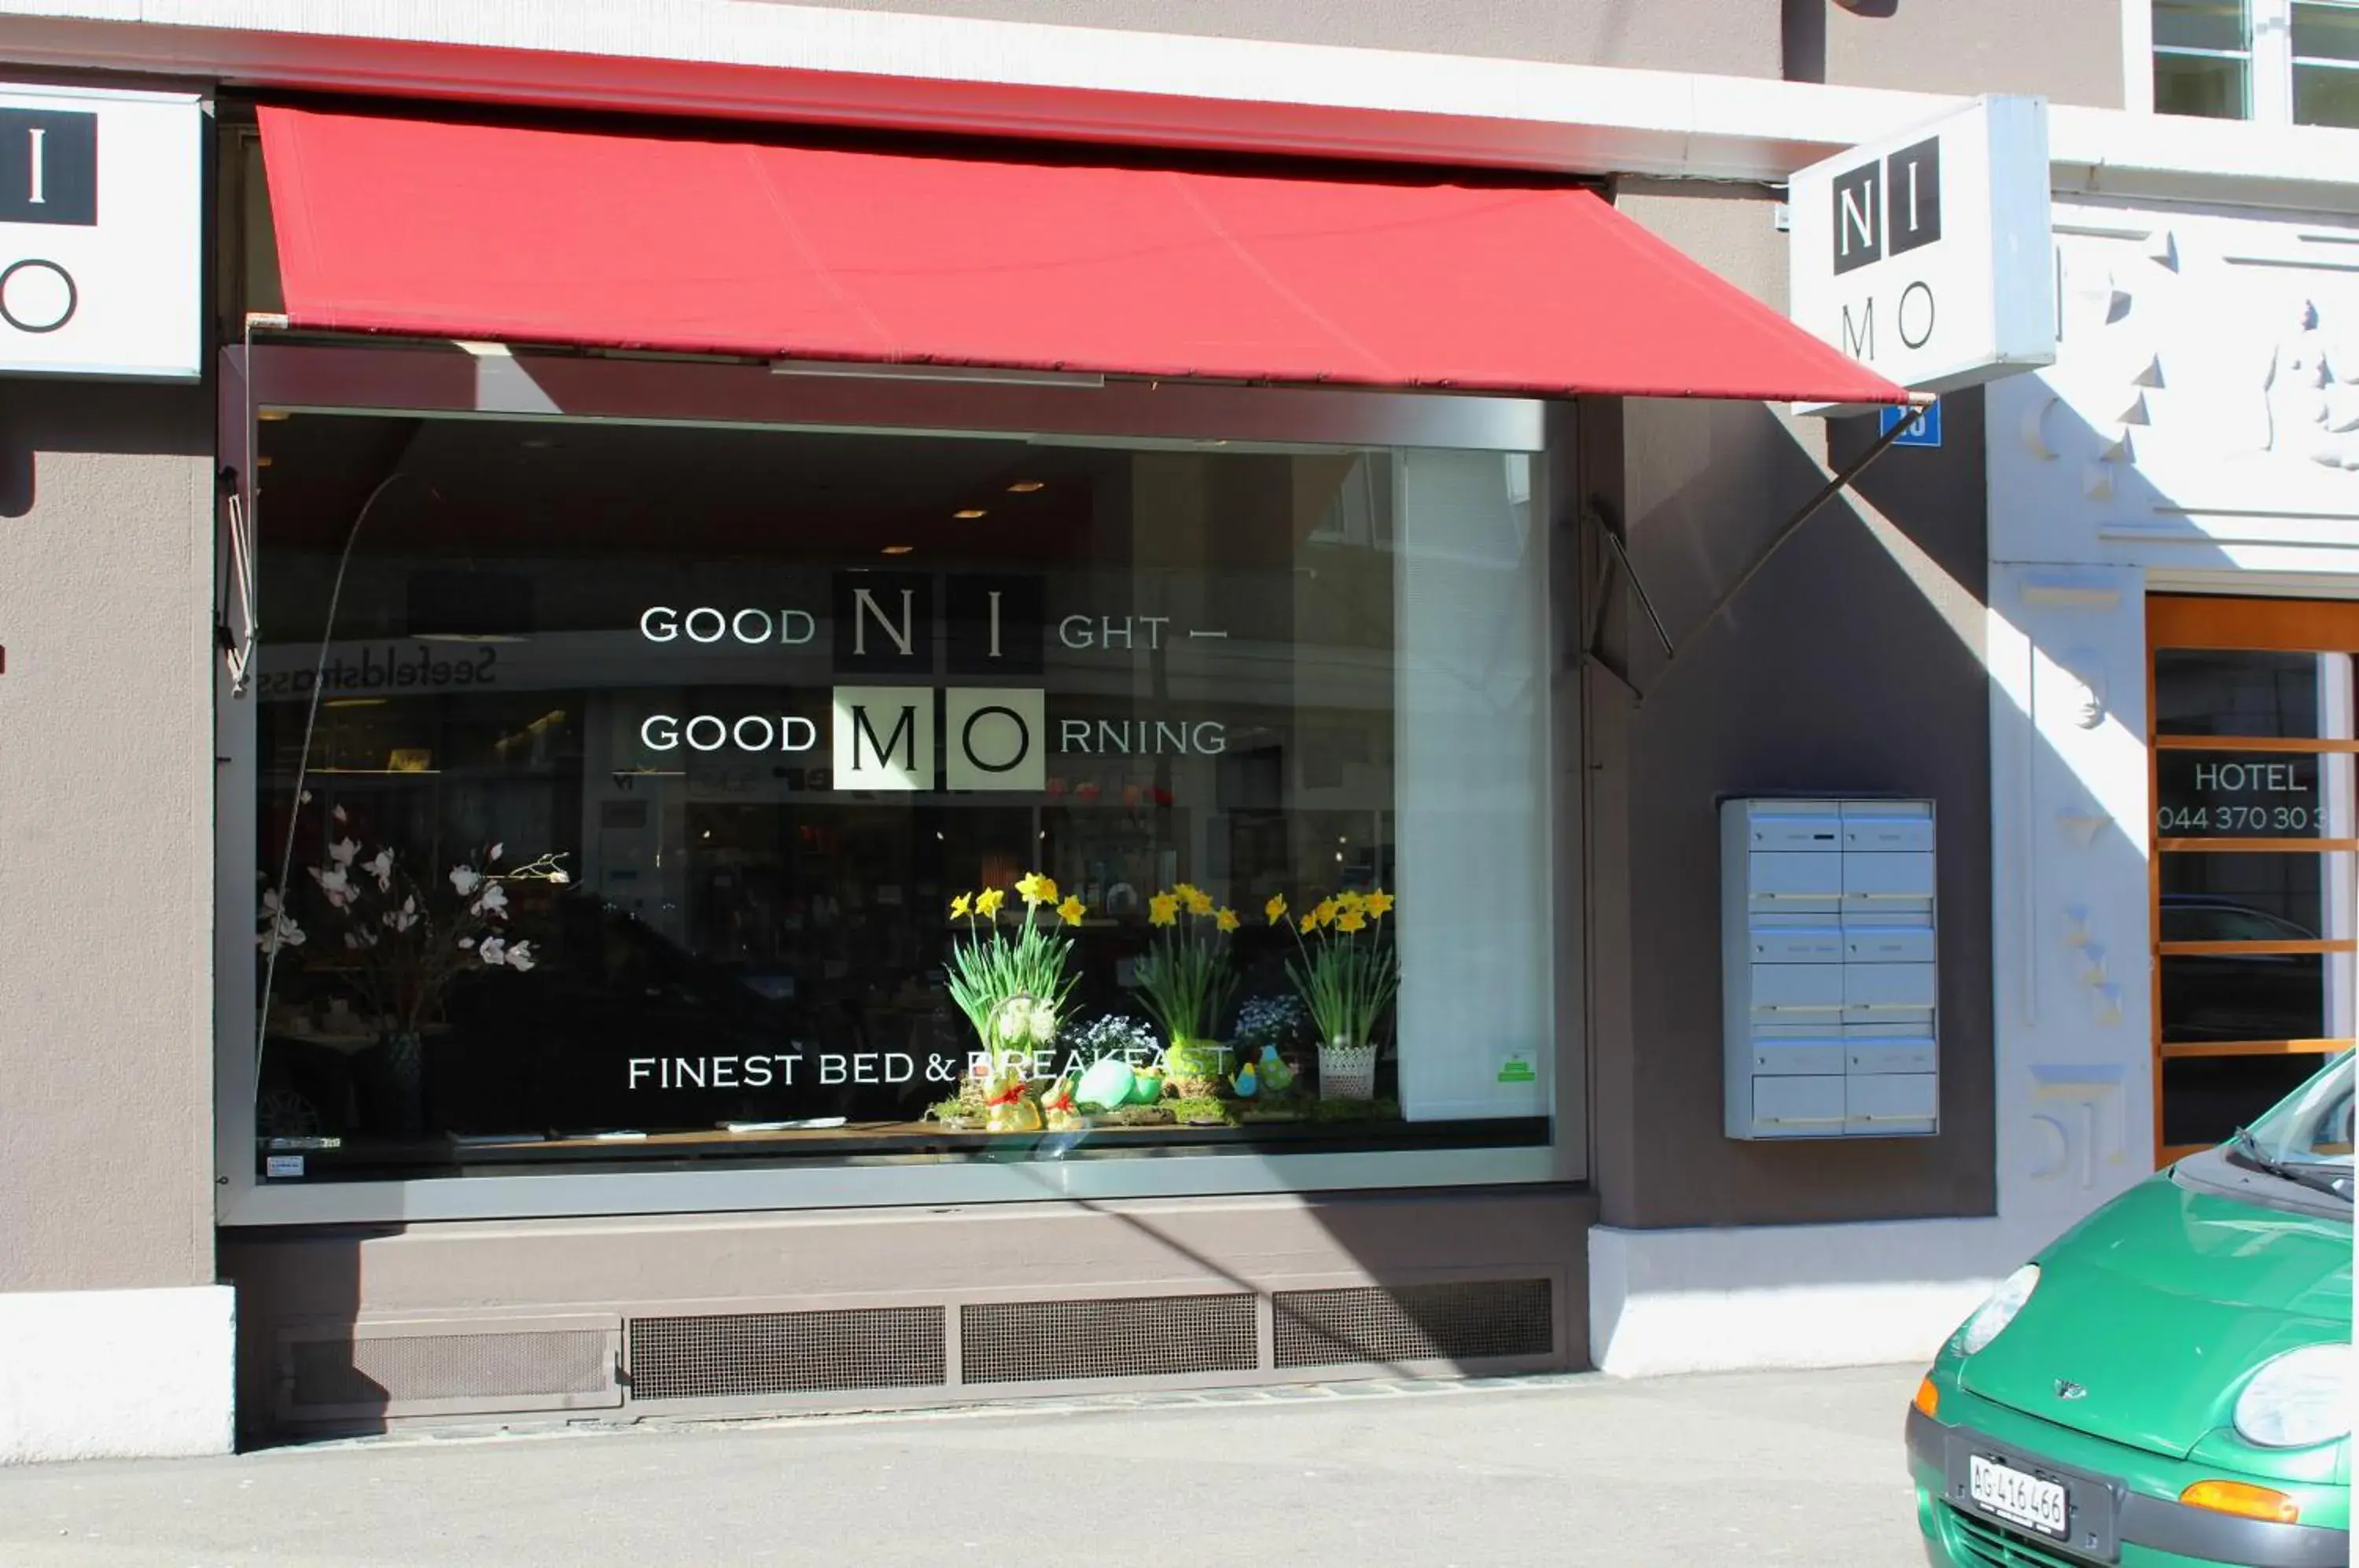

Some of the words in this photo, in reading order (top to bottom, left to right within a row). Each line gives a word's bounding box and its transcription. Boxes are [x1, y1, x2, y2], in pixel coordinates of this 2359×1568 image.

[639, 606, 816, 646] GOOD
[640, 714, 817, 752] GOOD
[2195, 763, 2308, 791] HOTEL
[2157, 806, 2209, 830] 044
[2216, 806, 2267, 830] 370
[2273, 806, 2307, 830] 30
[628, 1054, 804, 1090] FINEST
[819, 1052, 915, 1084] BED
[926, 1052, 955, 1082] &
